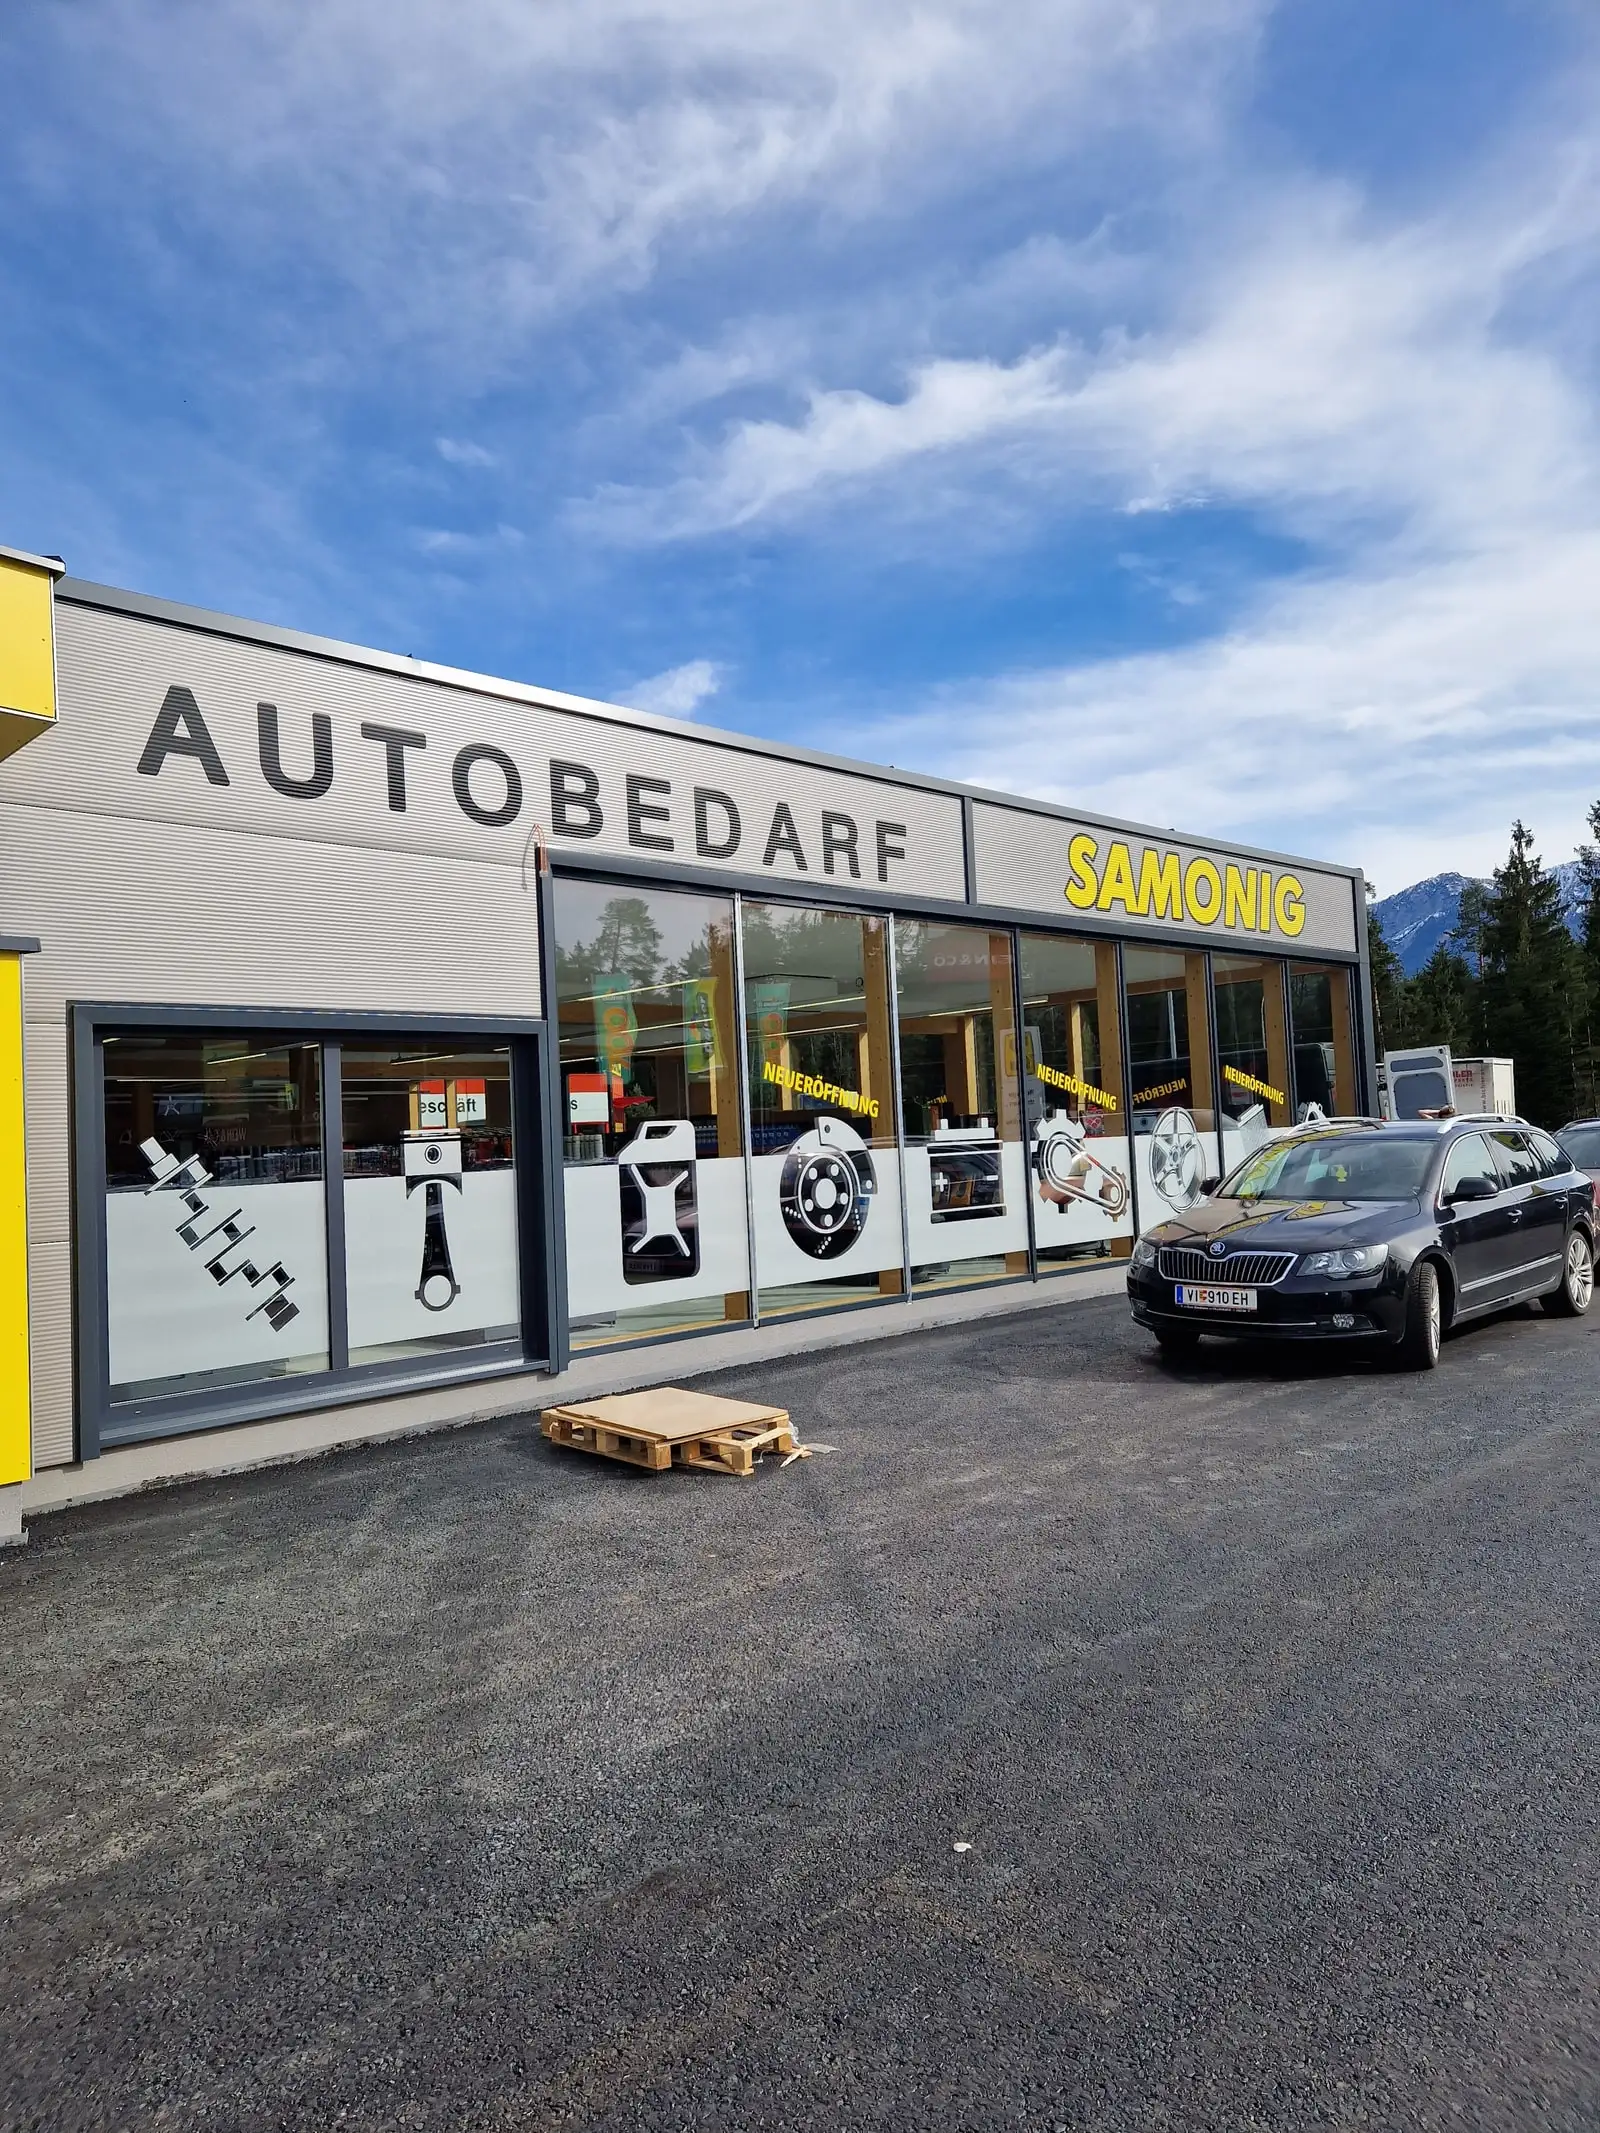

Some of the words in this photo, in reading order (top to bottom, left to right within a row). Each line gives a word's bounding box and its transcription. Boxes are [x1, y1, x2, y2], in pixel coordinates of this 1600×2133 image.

[136, 684, 908, 882] AUTOBEDARF
[1064, 833, 1307, 937] SAMONIG
[763, 1061, 880, 1118] NEUERÖFFNUNG
[1036, 1063, 1117, 1111] NEUERÖFFNUNG
[1224, 1064, 1285, 1105] NEUERÖFFNUNG
[1208, 1290, 1229, 1304] 910
[1232, 1292, 1248, 1305] EH
